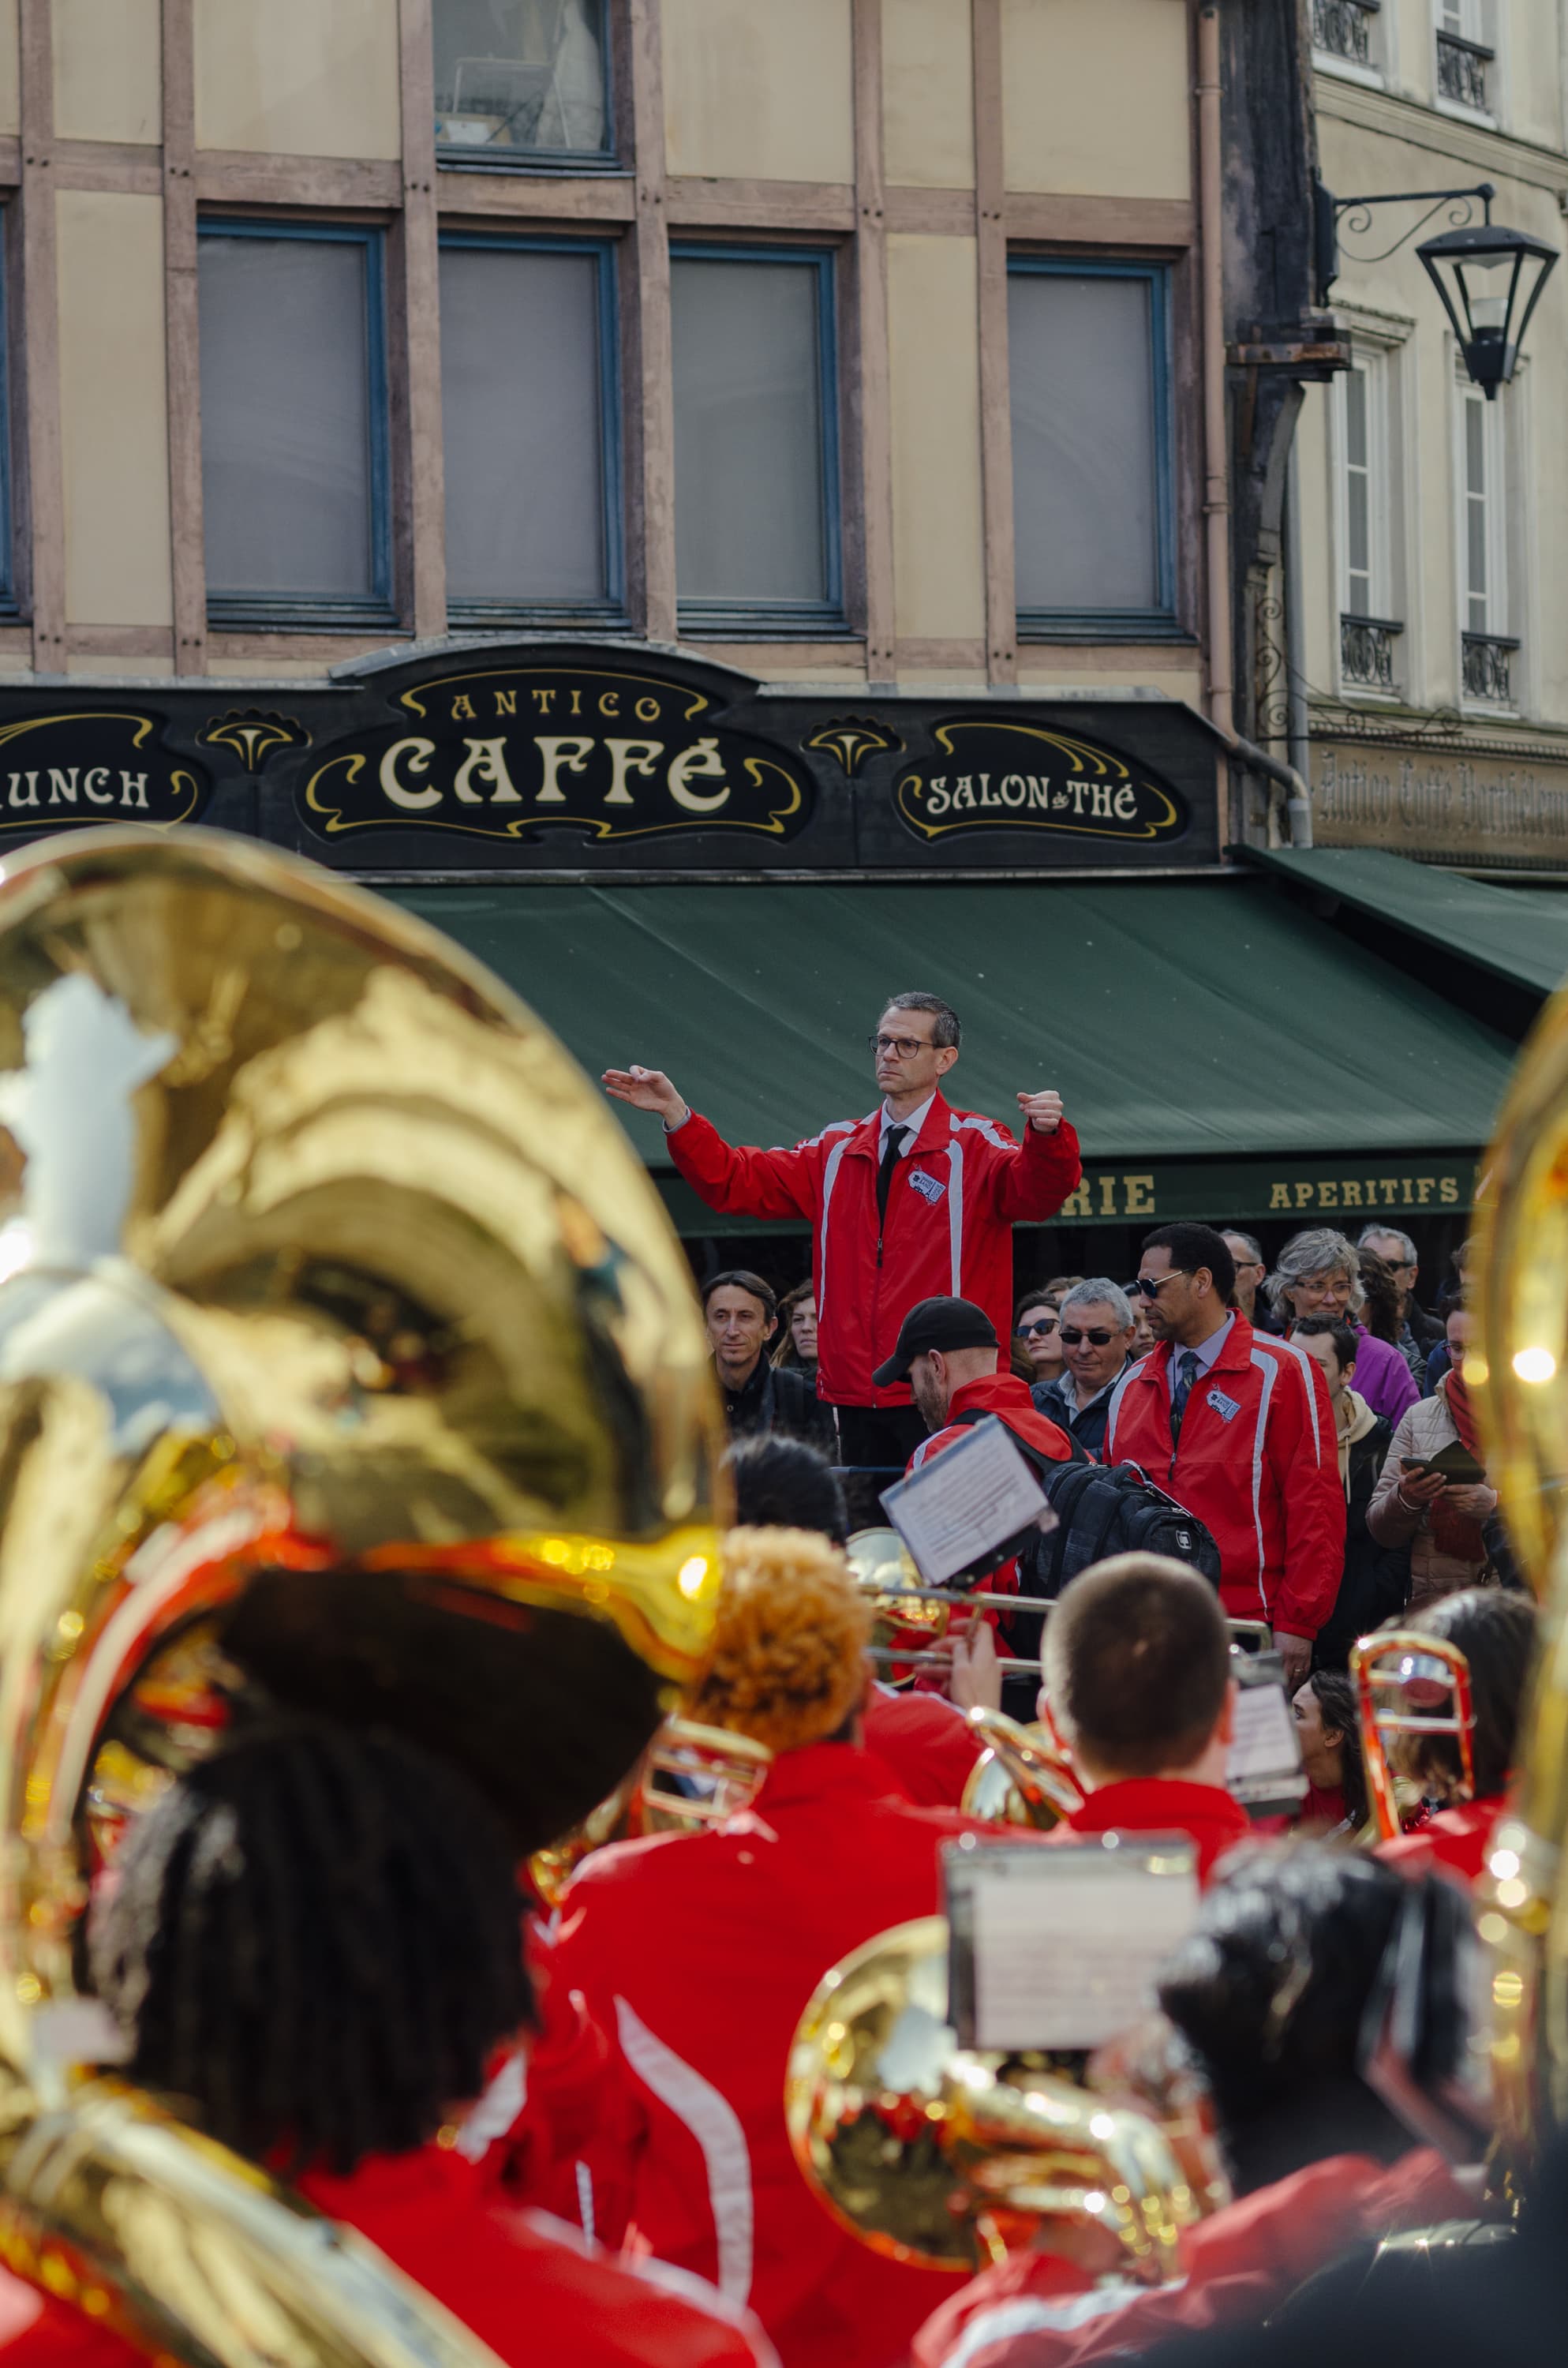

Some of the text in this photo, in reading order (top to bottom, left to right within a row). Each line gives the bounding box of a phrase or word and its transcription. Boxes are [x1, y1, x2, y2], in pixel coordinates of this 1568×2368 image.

[451, 689, 661, 721] ANTICO
[0, 767, 150, 809] UNCH
[926, 774, 1050, 815] SALON
[1269, 1177, 1458, 1208] APERITIFS
